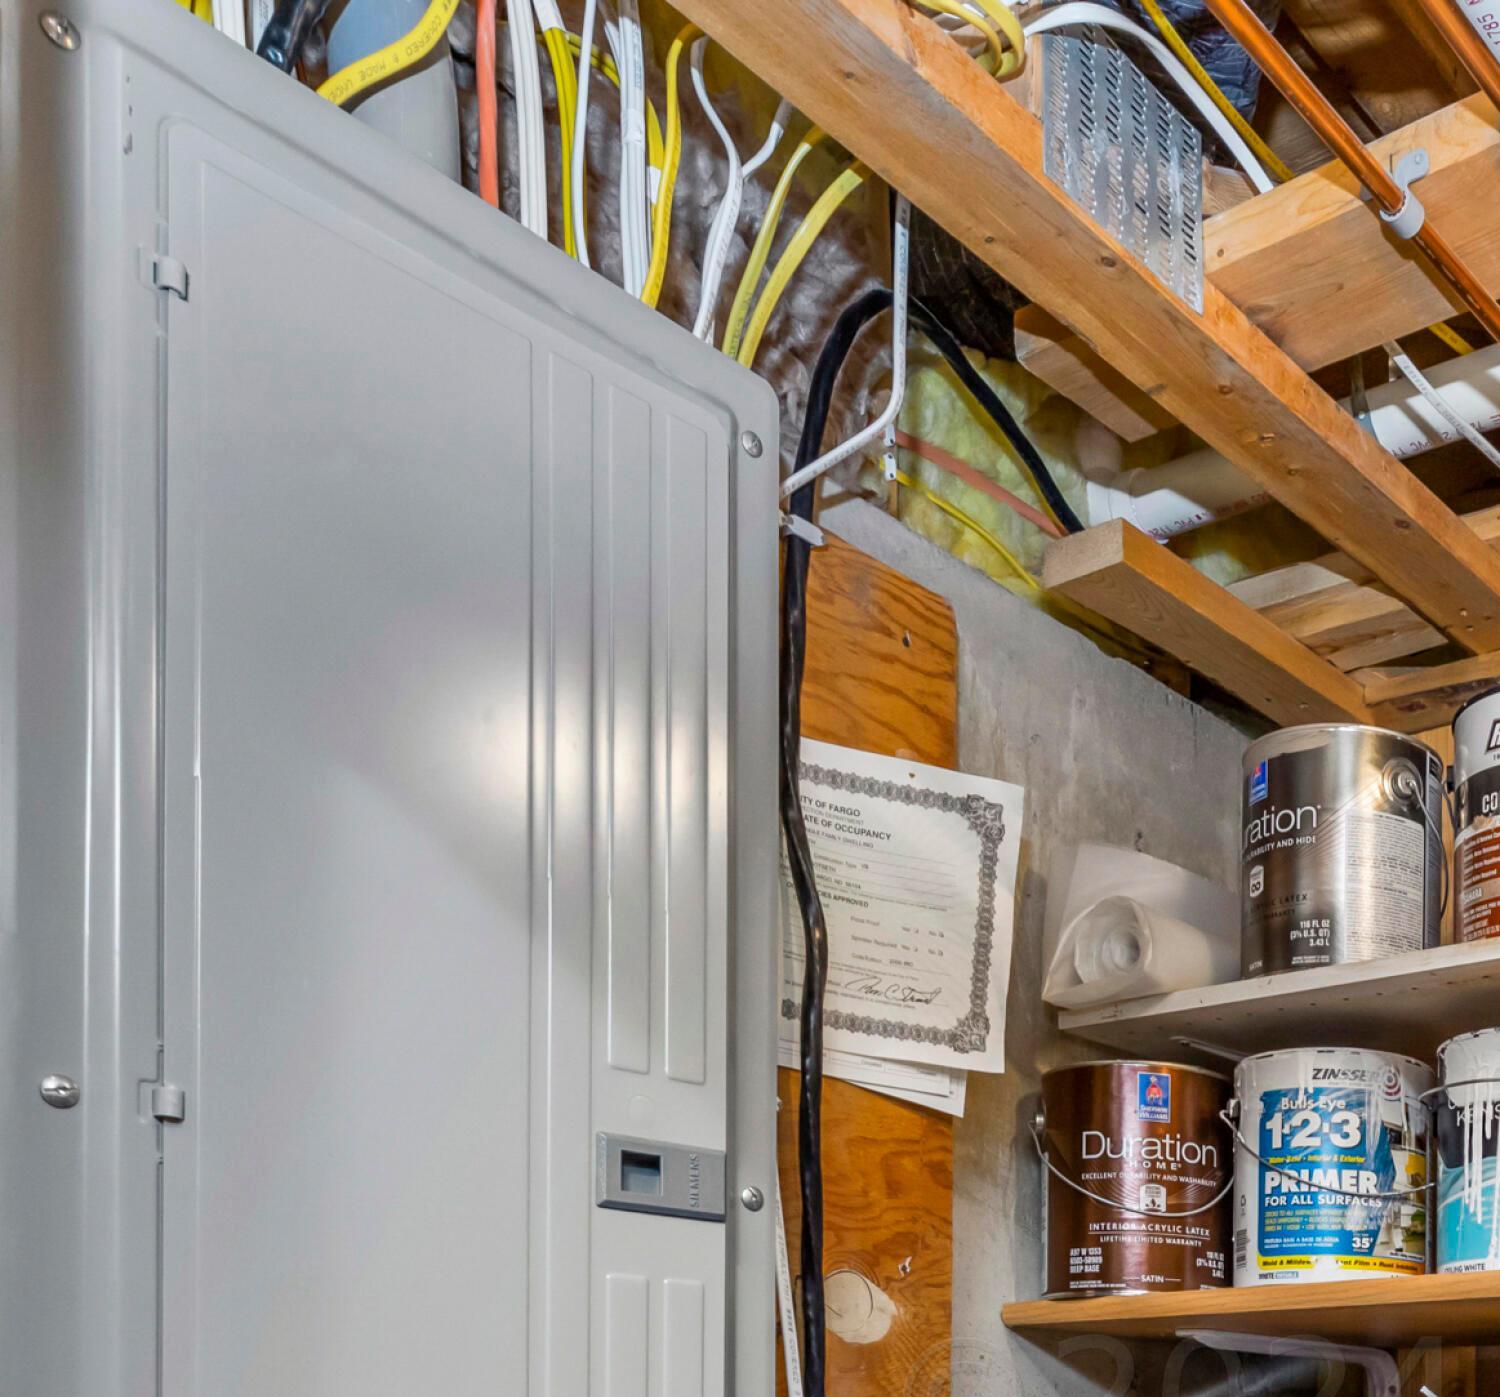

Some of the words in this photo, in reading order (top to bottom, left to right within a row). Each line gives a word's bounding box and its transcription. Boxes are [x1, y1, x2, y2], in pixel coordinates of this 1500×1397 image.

[828, 803, 861, 817] FARGO
[820, 819, 833, 828] OF
[834, 823, 892, 841] OCCUPANCY
[1277, 837, 1294, 850] AND
[1081, 1130, 1218, 1169] Duration
[1129, 1160, 1178, 1171] HOME
[1162, 1174, 1178, 1182] AND
[1264, 1168, 1379, 1196] PRIMER
[1264, 1196, 1287, 1208] FOR
[1290, 1195, 1315, 1206] ALL
[1317, 1194, 1383, 1208] SURFACES
[1089, 1222, 1136, 1232] INTERIOR
[1141, 1223, 1183, 1234] ACRYLIC
[1185, 1226, 1211, 1237] LATEX
[1100, 1235, 1133, 1244] LIFETIME
[1134, 1236, 1164, 1245] LIMITED
[1165, 1237, 1202, 1248] WARRANTY
[1464, 1262, 1487, 1272] WHITE
[1139, 1274, 1165, 1284] SATIN
